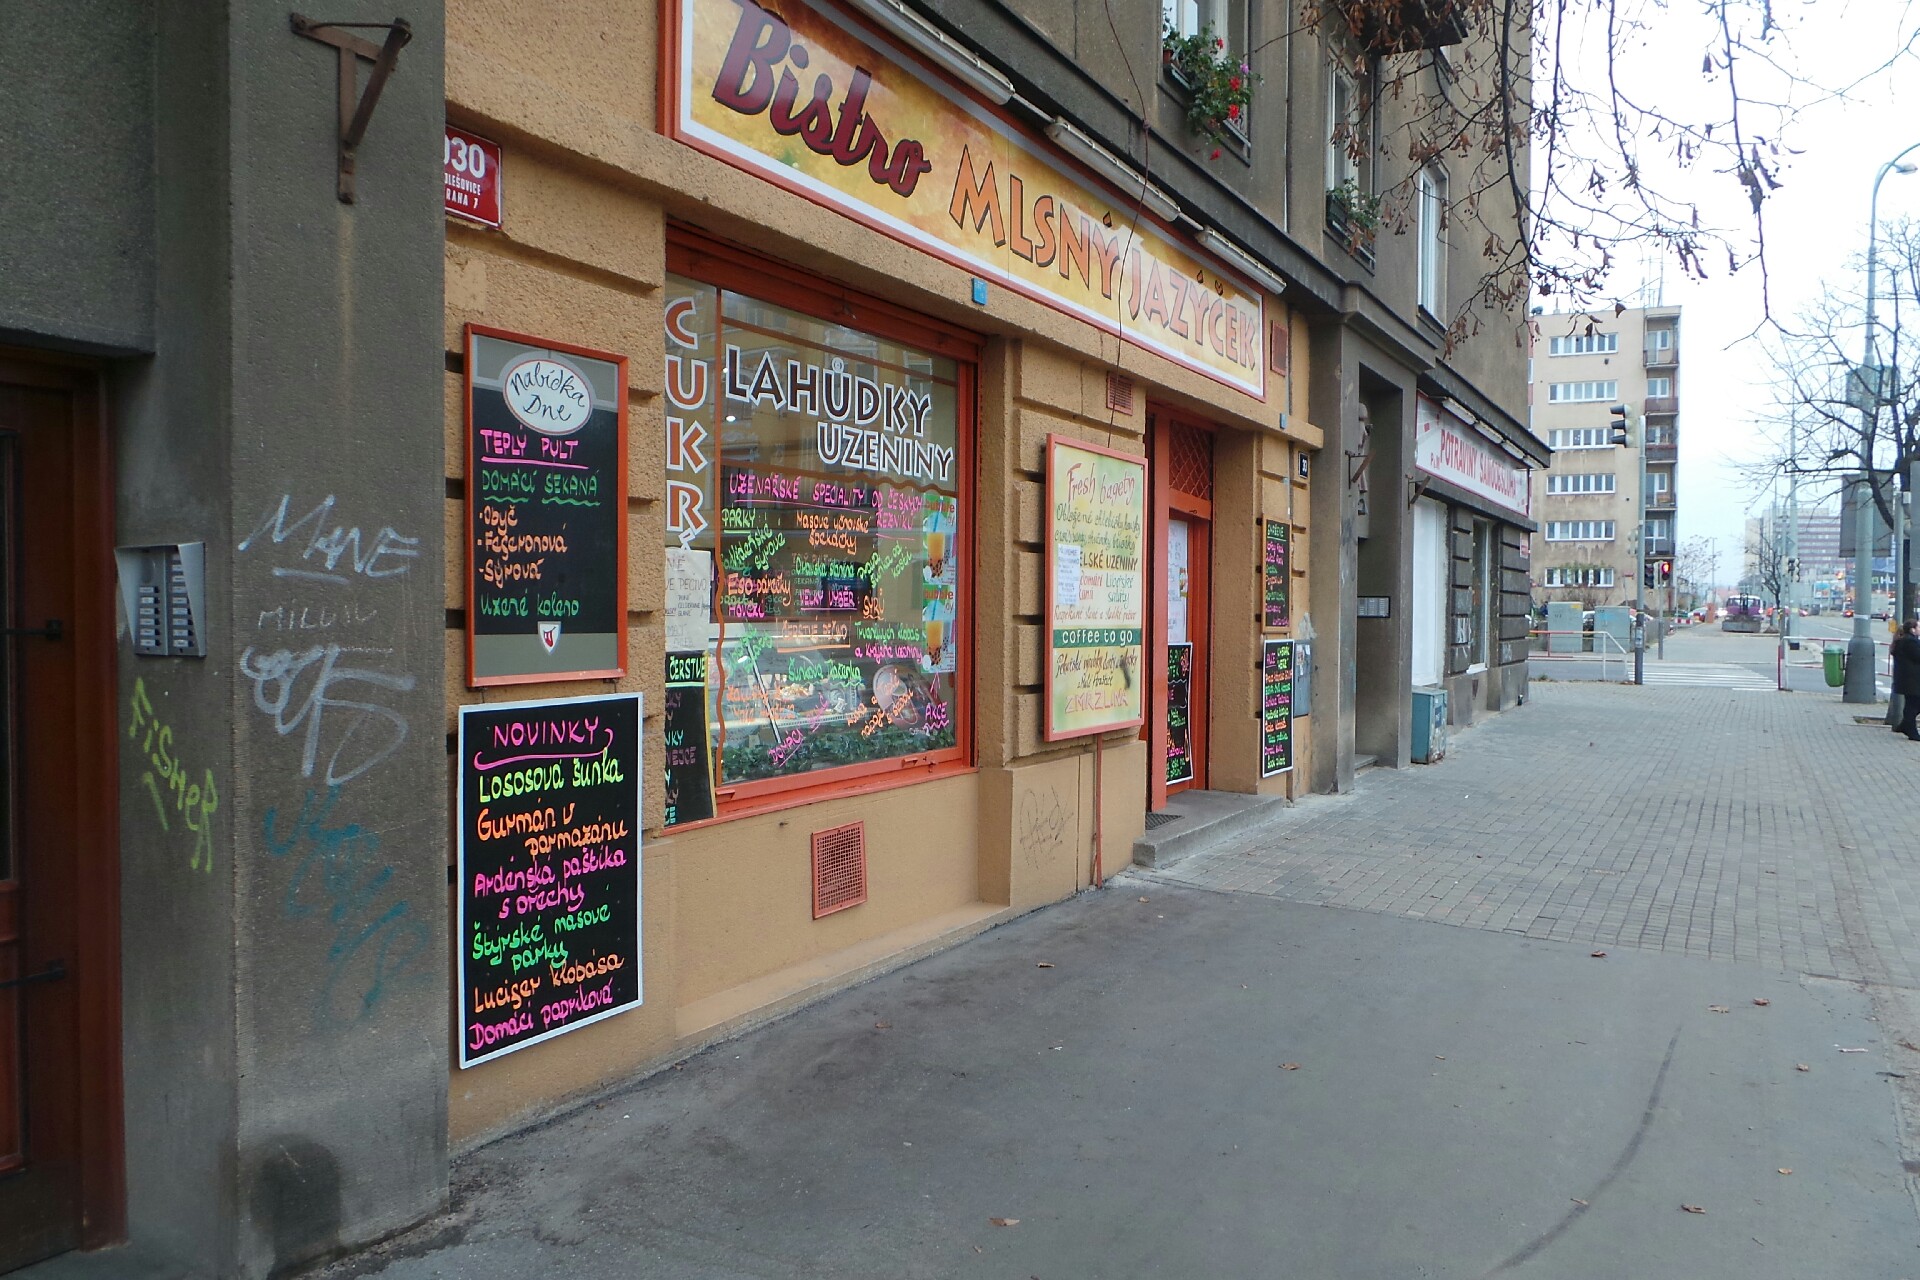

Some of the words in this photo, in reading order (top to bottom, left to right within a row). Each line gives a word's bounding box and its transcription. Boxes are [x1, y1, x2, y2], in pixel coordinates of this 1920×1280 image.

[711, 0, 932, 198] Bistro
[473, 197, 479, 209] 7
[949, 144, 1120, 300] MLSNÝ
[1127, 241, 1256, 371] JAZÝČEK
[523, 393, 572, 422] Dne
[725, 344, 931, 438] LAHŮDKY
[480, 424, 527, 457] TEPLÝ
[541, 439, 579, 459] PULT
[817, 421, 953, 481] UZENINY
[1441, 428, 1478, 480] POTRAVINY
[544, 469, 600, 497] SEKANÁ
[1067, 462, 1096, 504] Fresh
[1100, 470, 1135, 506] bagety
[1105, 554, 1139, 571] UZENINY
[537, 591, 580, 617] koleno
[1062, 629, 1100, 644] coffee
[1104, 629, 1116, 643] to
[1120, 630, 1133, 646] go
[925, 702, 948, 720] AKCE
[1065, 689, 1129, 714] ZMRZLINA
[493, 715, 599, 749] NOVINKY
[478, 757, 565, 803] Lososová
[572, 747, 624, 788] šunka
[477, 798, 557, 841] Gurmán
[498, 897, 510, 919] s
[516, 881, 585, 914] ořechy
[549, 949, 625, 987] klobása
